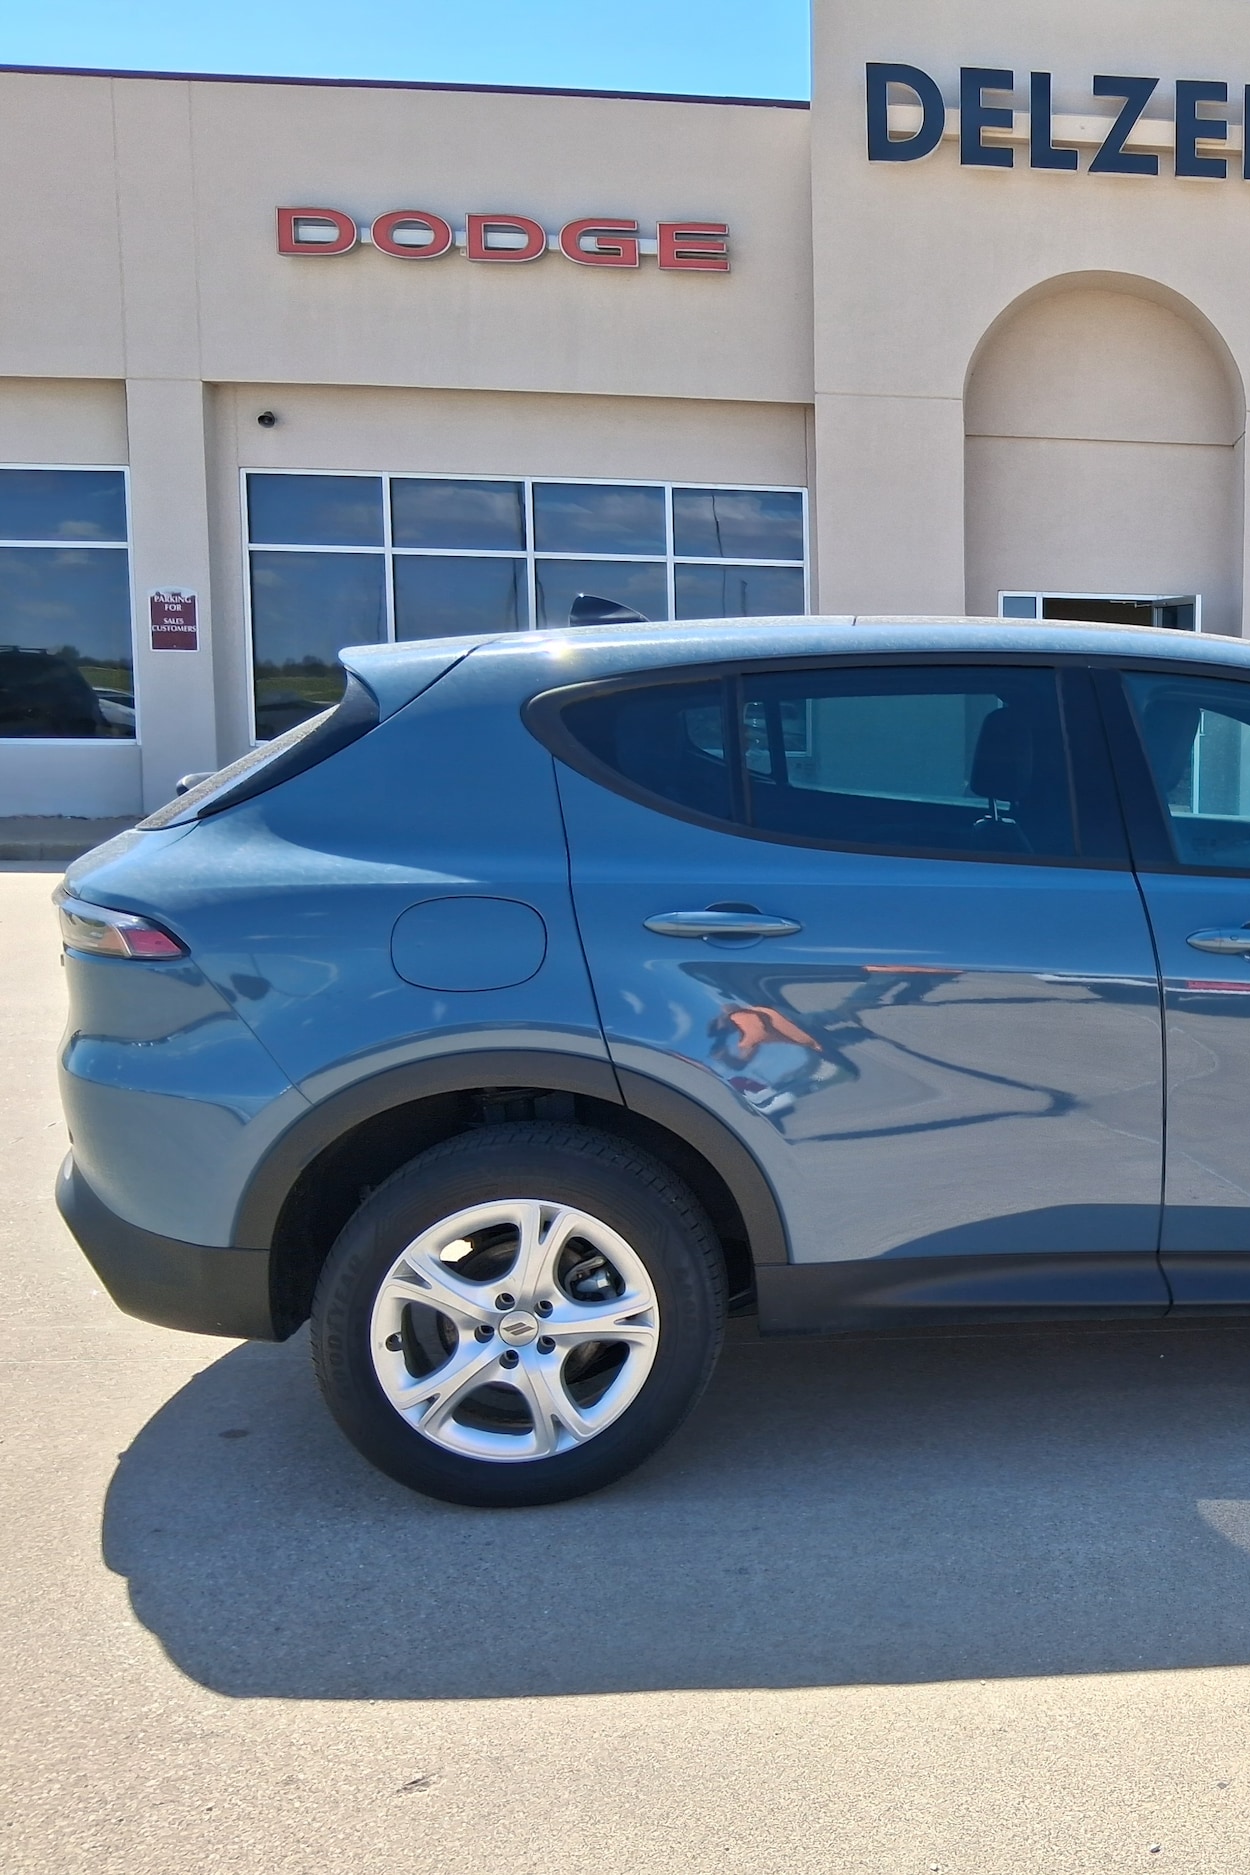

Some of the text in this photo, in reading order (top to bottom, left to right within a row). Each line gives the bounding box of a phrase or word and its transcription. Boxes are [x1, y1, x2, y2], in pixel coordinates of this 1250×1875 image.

[275, 206, 731, 272] DODGE
[154, 594, 192, 603] PARKING
[164, 603, 182, 612] FOR
[163, 617, 184, 625] SALES
[151, 625, 197, 633] CUSTOMERS
